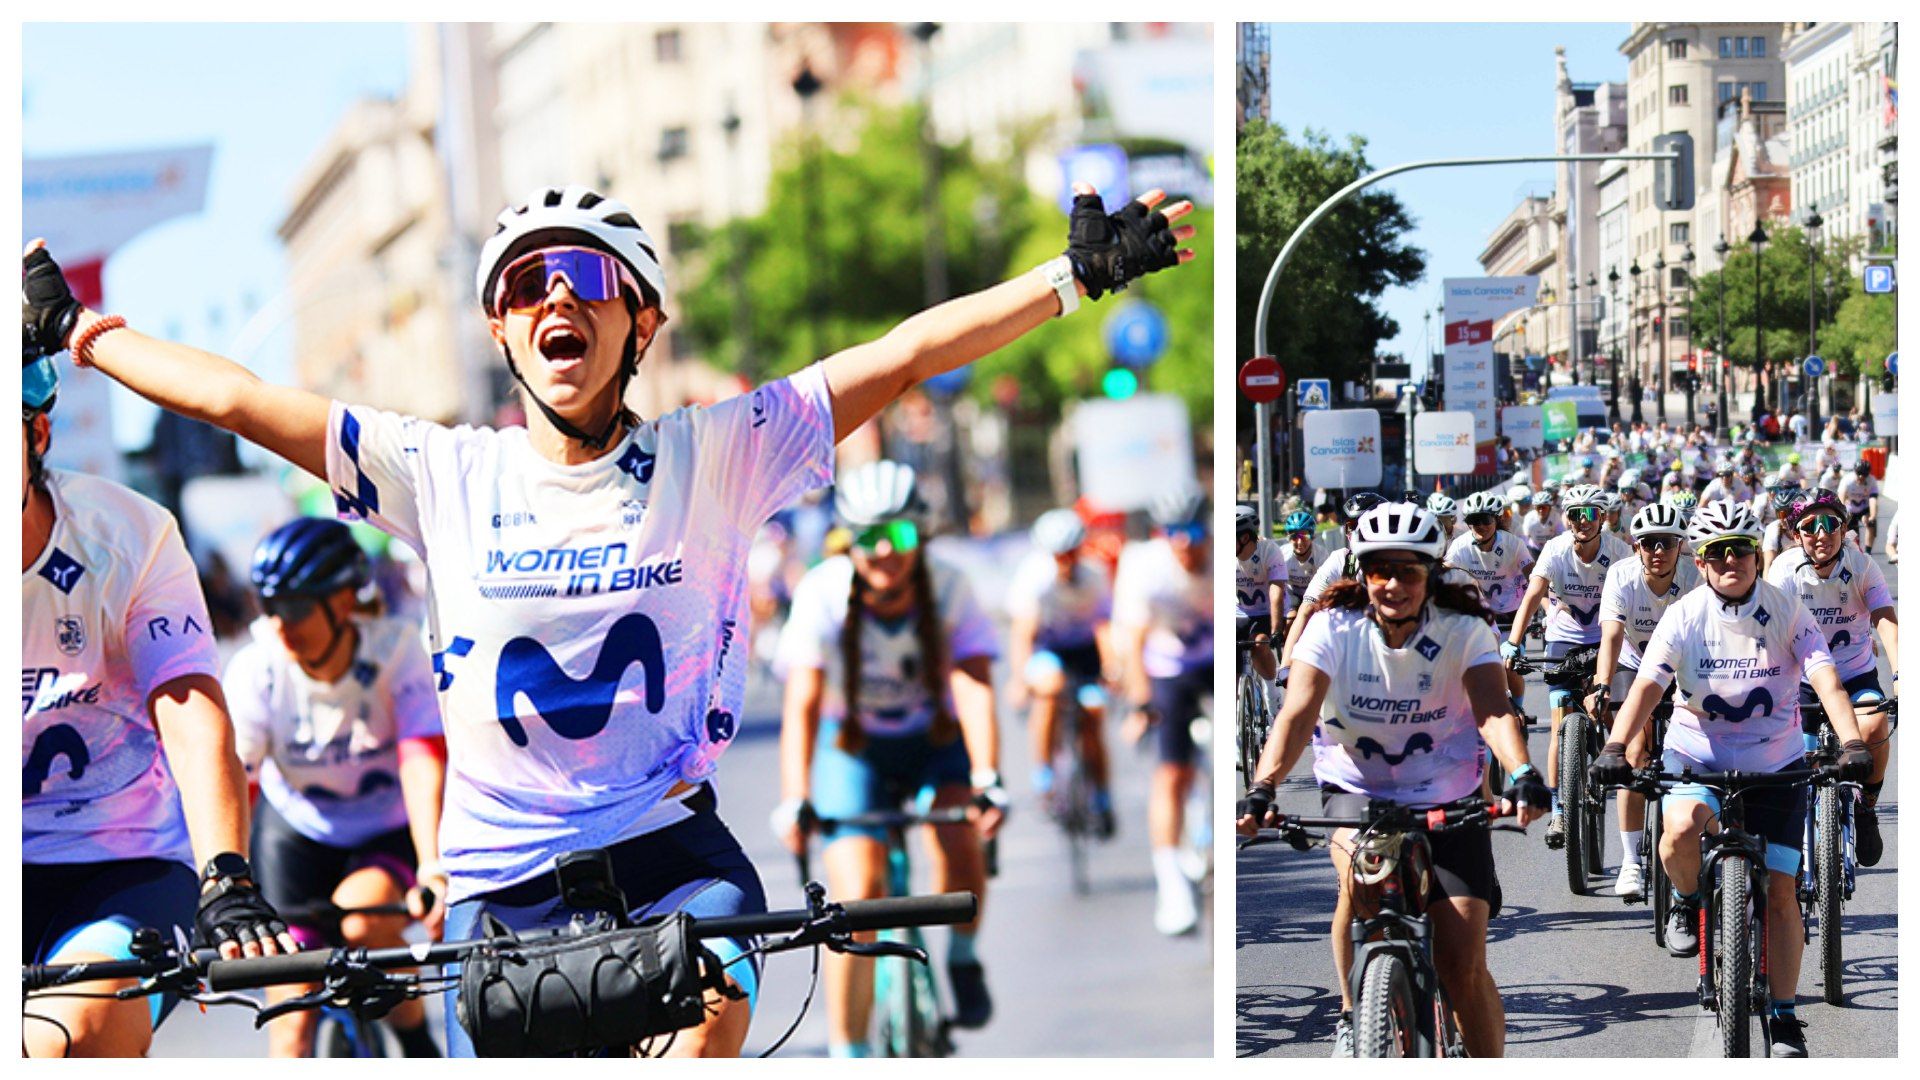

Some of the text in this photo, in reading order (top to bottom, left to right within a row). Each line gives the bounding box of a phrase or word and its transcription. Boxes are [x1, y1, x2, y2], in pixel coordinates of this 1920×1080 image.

[1871, 269, 1886, 289] P
[1474, 286, 1514, 296] Canarias
[1458, 326, 1469, 340] 15
[1332, 437, 1356, 447] Islas
[1435, 432, 1454, 441] Islas
[1310, 445, 1356, 456] Canarias
[1419, 440, 1454, 448] Canarias
[486, 542, 628, 574] WOMEN
[566, 558, 682, 596] IN BIKE
[1564, 583, 1600, 592] WOMEN
[1822, 612, 1858, 625] IN BIKE
[1700, 657, 1758, 669] WOMEN
[1733, 666, 1781, 680] IN BIKE
[1351, 694, 1421, 712] WOMEN
[1390, 706, 1448, 725] IN BIKE
